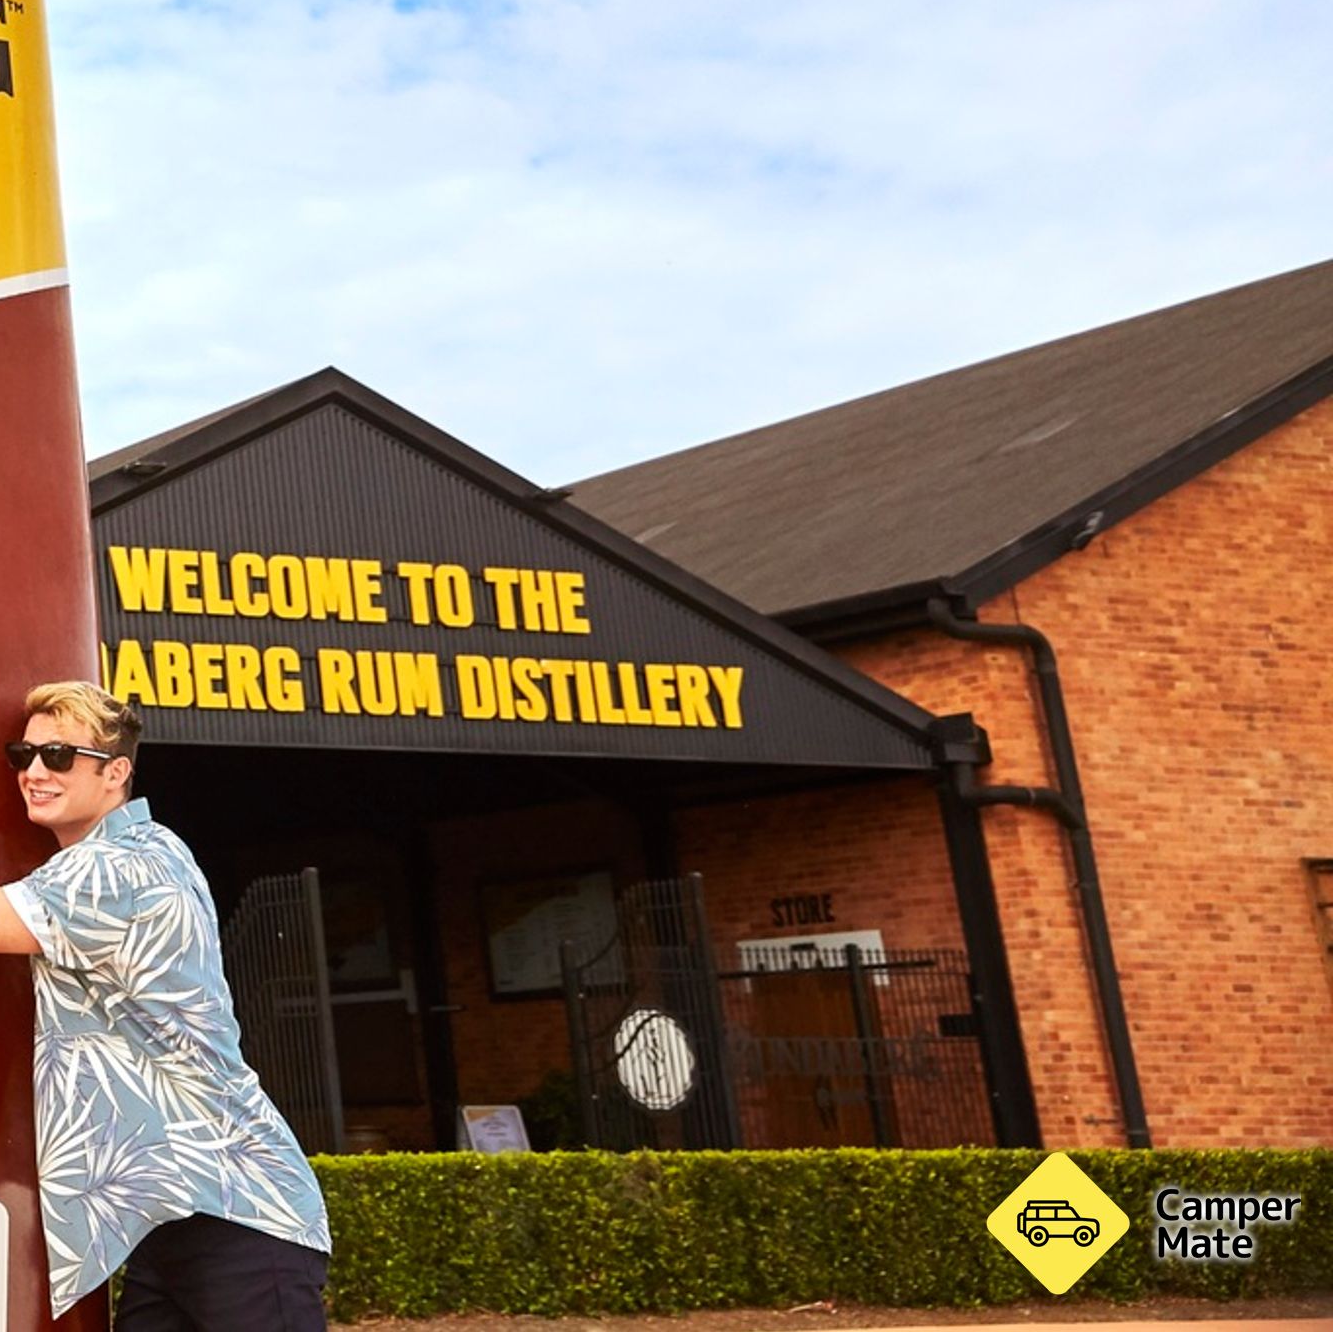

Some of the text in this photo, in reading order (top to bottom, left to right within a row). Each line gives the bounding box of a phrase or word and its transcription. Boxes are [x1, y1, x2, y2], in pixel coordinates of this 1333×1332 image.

[109, 545, 591, 635] WELCOME TO THE
[101, 639, 744, 729] ABERG RUM DISTILLERY
[770, 894, 835, 928] STORE
